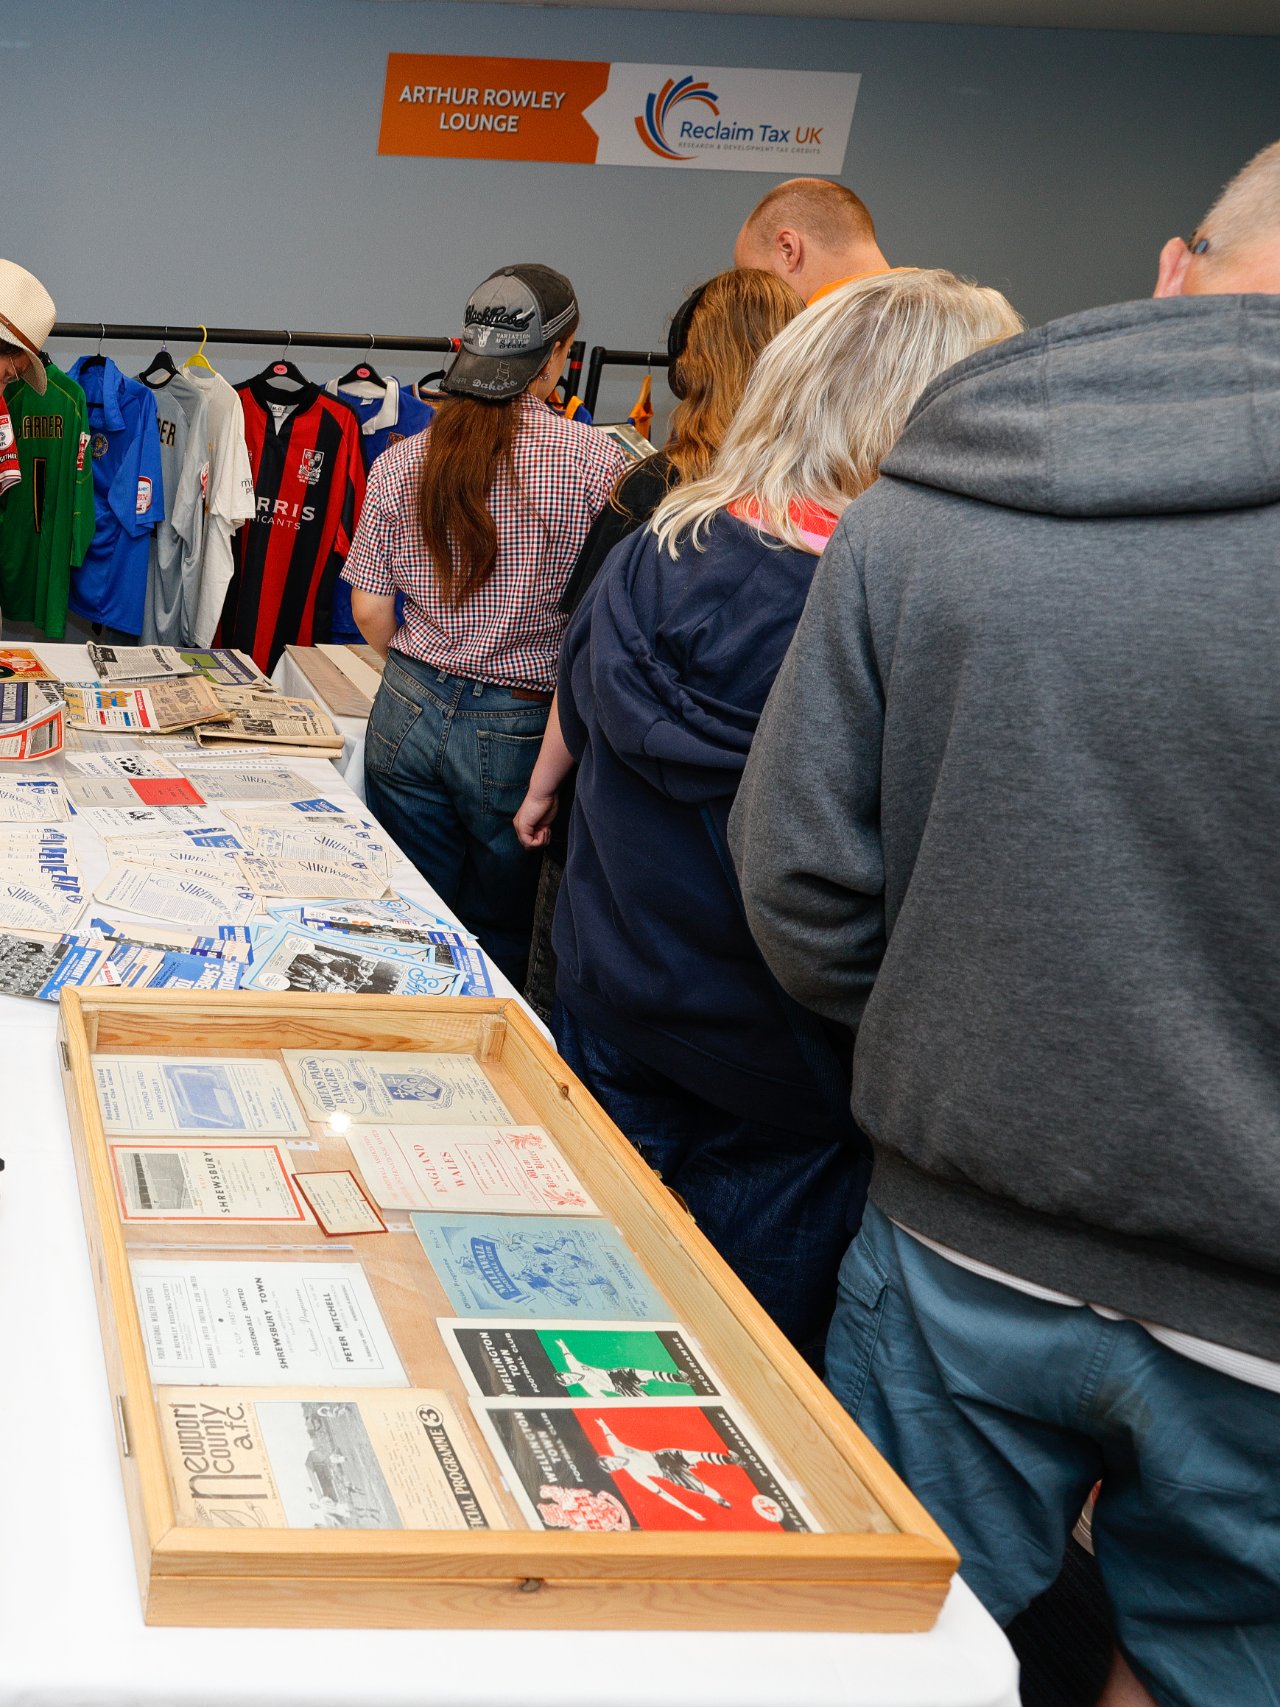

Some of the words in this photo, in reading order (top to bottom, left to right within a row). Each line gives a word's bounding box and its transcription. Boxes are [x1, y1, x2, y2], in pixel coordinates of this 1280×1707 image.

[400, 85, 479, 105] ARTHUR
[483, 87, 567, 110] ROWLEY
[439, 112, 520, 133] LOUNGE
[680, 120, 755, 142] Reclaim
[759, 124, 791, 144] Tax
[795, 125, 824, 145] UK
[723, 143, 774, 153] DEVELOPMENT
[790, 146, 821, 155] CREDITS
[19, 415, 64, 439] ARNER
[252, 516, 301, 530] RICANTS
[256, 496, 316, 521] RRIS
[135, 1070, 146, 1088] UNITED
[305, 1058, 317, 1081] PARK
[322, 1066, 346, 1105] RANGERS
[140, 1091, 154, 1120] SOUTHEND
[151, 1077, 166, 1112] SHREWSBURY
[201, 1151, 231, 1213] SHREWSBURY
[410, 1144, 449, 1192] ENGLAND
[437, 1151, 469, 1186] WALES
[440, 1258, 462, 1286] Programme
[472, 1244, 511, 1298] MILLWALL
[491, 1261, 517, 1294] FOOTBALL
[605, 1251, 635, 1290] SHREWSBURY
[236, 1287, 251, 1314] UNITED
[255, 1277, 270, 1306] TOWN
[322, 1292, 344, 1332] MITCHELL
[243, 1315, 261, 1356] ROSSENDALE
[266, 1309, 288, 1369] SHREWSBURY
[336, 1335, 354, 1362] PETER
[504, 1333, 521, 1356] CLUB
[480, 1332, 517, 1393] WELLINGTON
[501, 1349, 520, 1378] TOWN
[514, 1356, 541, 1393] FOOTBALL
[672, 1337, 715, 1393] PROGRAMME
[200, 1402, 235, 1474] county
[227, 1402, 253, 1450] a.f.c.
[540, 1412, 558, 1436] CLUB
[422, 1427, 468, 1495] PROGRAMME
[514, 1411, 553, 1484] WELLINGTON
[537, 1430, 561, 1464] TOWN
[554, 1437, 584, 1483] FOOTBALL
[718, 1413, 768, 1477] PROGRAMME
